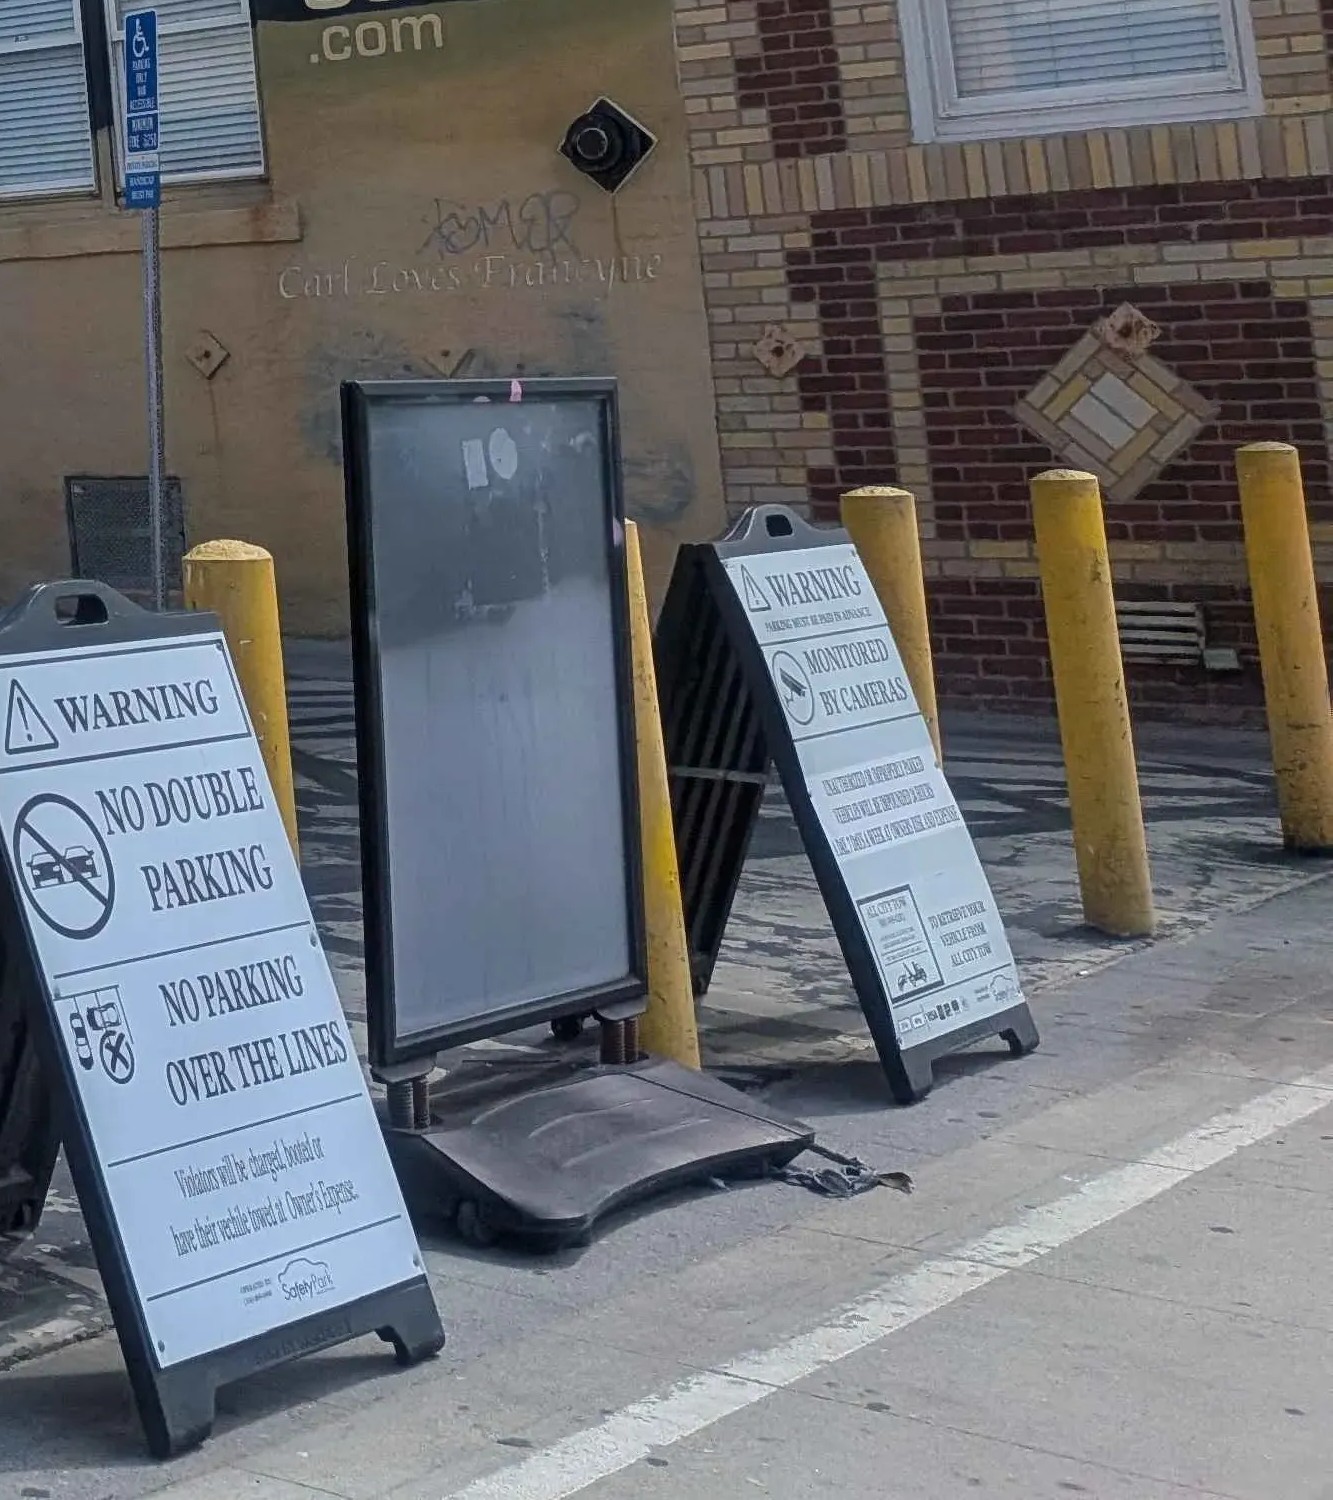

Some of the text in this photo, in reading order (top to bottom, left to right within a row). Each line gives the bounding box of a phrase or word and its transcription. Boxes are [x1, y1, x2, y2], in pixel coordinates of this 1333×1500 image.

[309, 13, 444, 64] .com
[279, 256, 350, 299] Carl
[365, 258, 461, 296] Loves
[765, 565, 862, 607] WARNING
[803, 638, 889, 675] MONITORED
[54, 679, 219, 734] WARNING
[819, 676, 908, 716] BY CAMERAS
[95, 766, 264, 835] NO DOUBLE
[141, 844, 274, 911] PARKING
[158, 955, 304, 1027] NO PARKING
[165, 1020, 348, 1106] OVER THE LINES
[174, 1165, 220, 1198] Violators
[216, 1153, 238, 1188] will
[232, 1153, 249, 1183] be
[281, 1131, 310, 1168] booted
[311, 1137, 325, 1160] or
[169, 1225, 198, 1257] have
[193, 1215, 220, 1249] their
[247, 1196, 278, 1232] towed
[275, 1198, 288, 1223] at
[285, 1182, 324, 1220] Owner's
